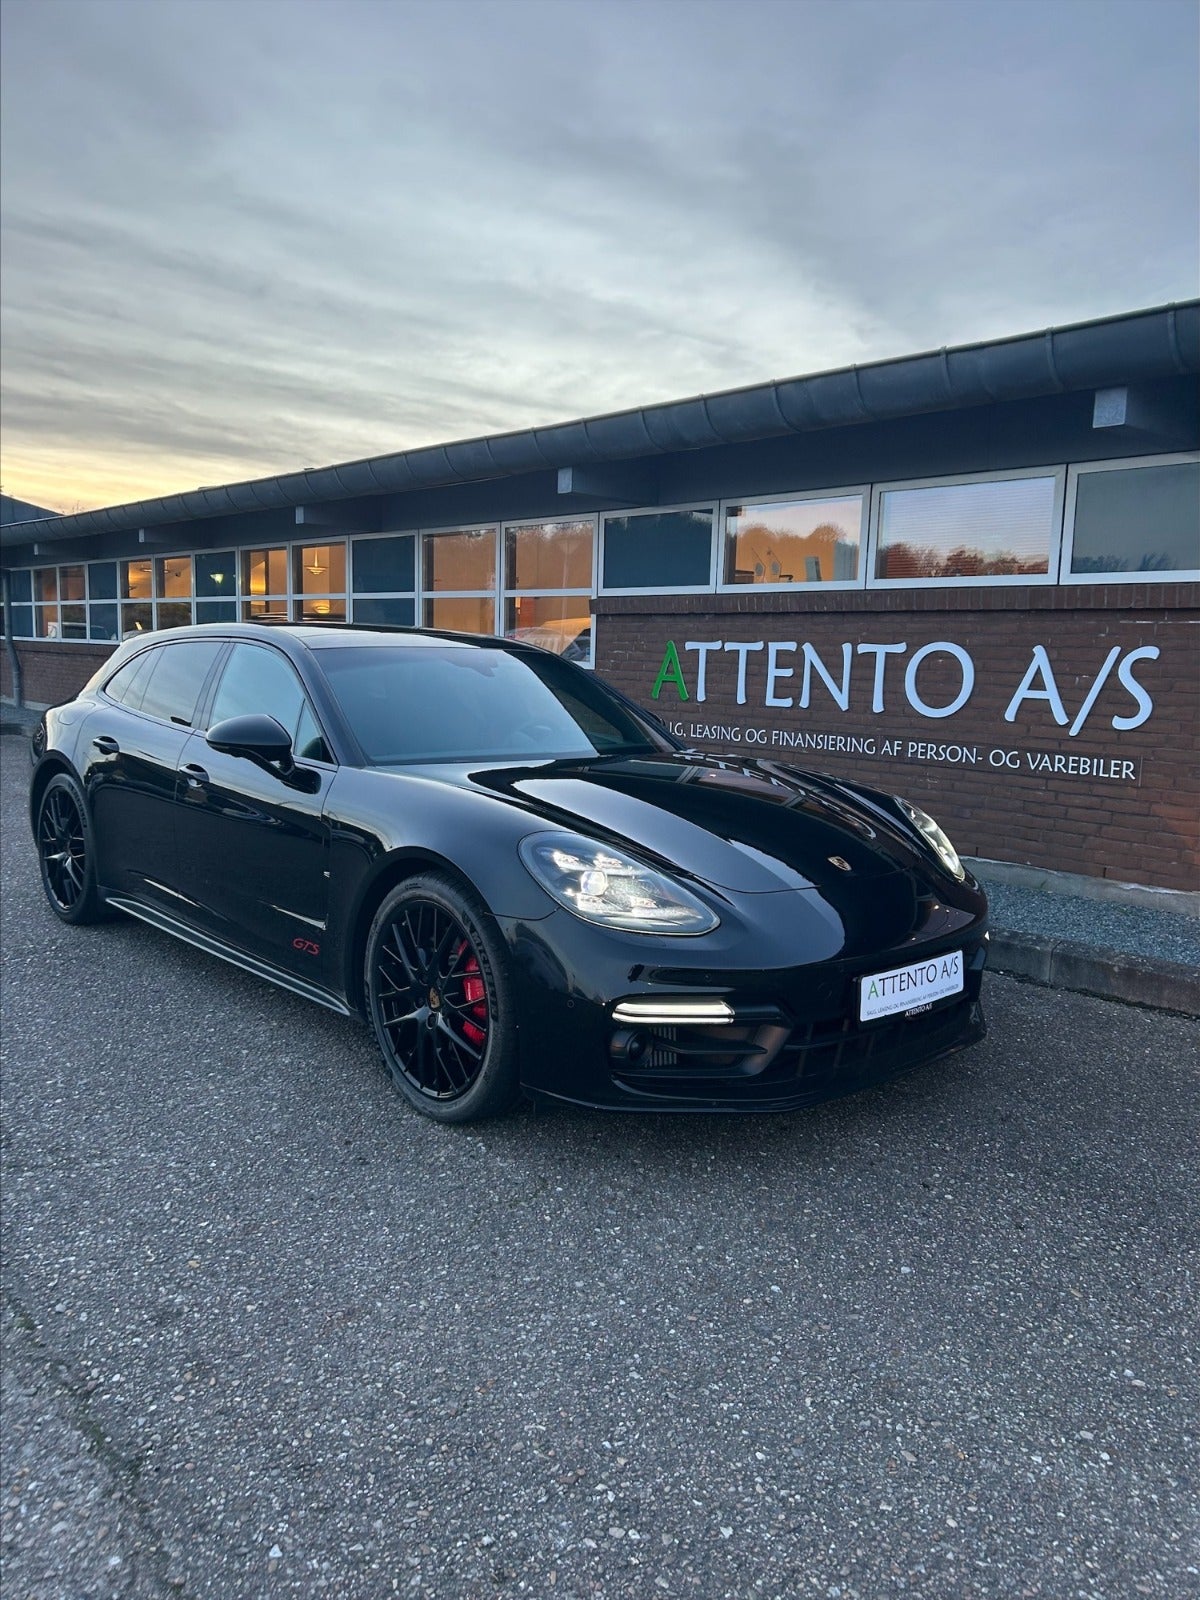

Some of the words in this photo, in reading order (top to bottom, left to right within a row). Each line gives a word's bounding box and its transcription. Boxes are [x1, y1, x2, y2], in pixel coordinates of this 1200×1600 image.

[651, 639, 975, 719] ATTENTO
[1004, 644, 1161, 737] A/S
[669, 721, 687, 738] LG,
[690, 723, 742, 742] LEASING
[745, 728, 768, 744] OG
[771, 730, 876, 755] FINANSIERING
[881, 740, 903, 756] AF
[908, 741, 983, 764] PERSON-
[989, 749, 1021, 769] OG
[1027, 752, 1136, 780] VAREBILER
[292, 937, 320, 956] GTS
[868, 964, 937, 1000] ATTENTO
[940, 956, 959, 980] A/S
